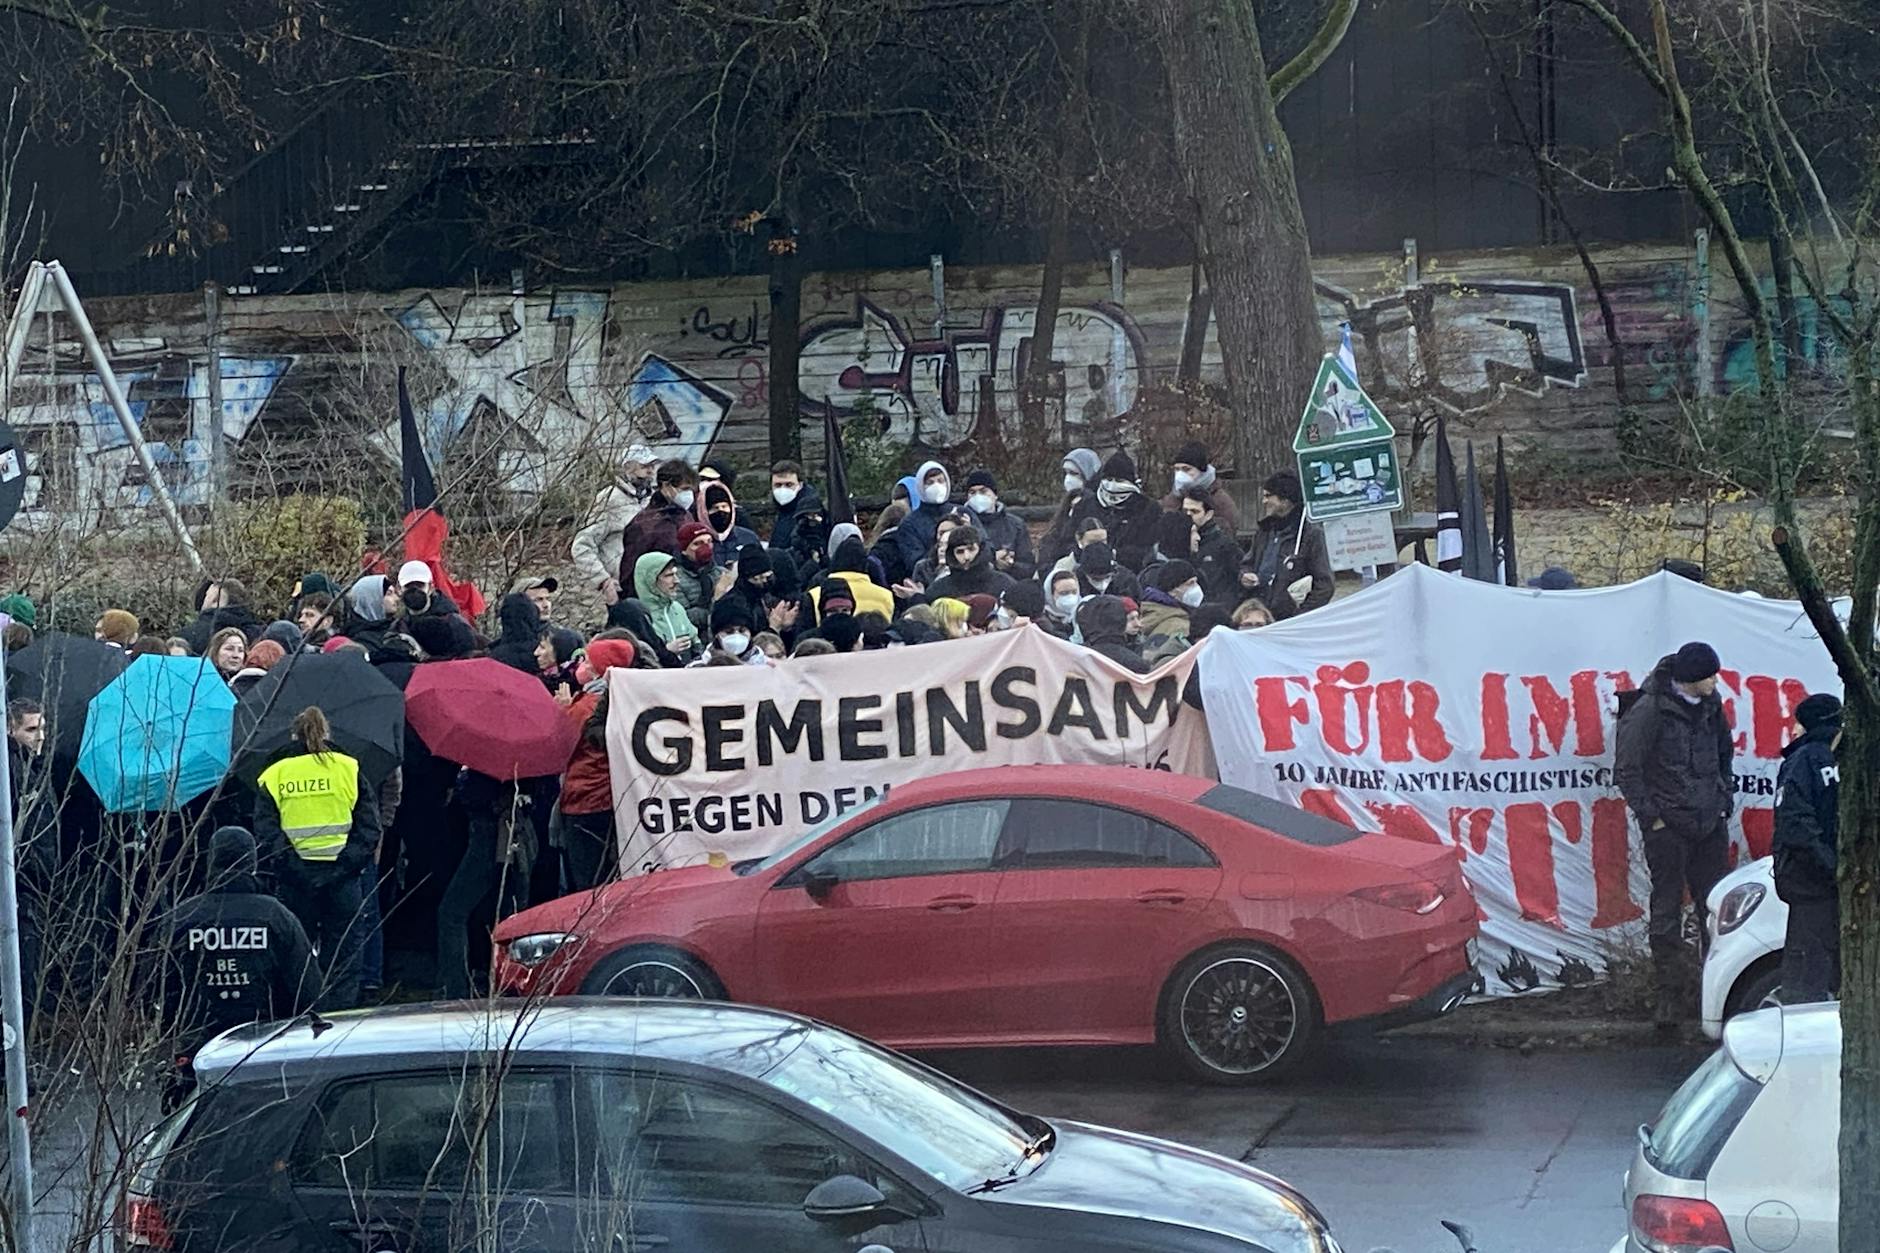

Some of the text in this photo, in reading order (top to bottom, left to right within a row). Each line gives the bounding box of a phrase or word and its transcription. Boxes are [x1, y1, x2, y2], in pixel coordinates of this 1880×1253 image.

[632, 665, 1183, 776] GEMEINSAM
[1254, 660, 1453, 763] FÜR
[279, 778, 331, 795] POLIZEI
[1274, 762, 1305, 783] 10
[1314, 765, 1387, 791] JAHRE
[1395, 766, 1618, 793] ANTIFASCHISTISC
[638, 791, 783, 834] GEGEN
[188, 926, 268, 951] POLIZEI
[206, 972, 250, 986] 21111
[216, 958, 238, 972] BE
